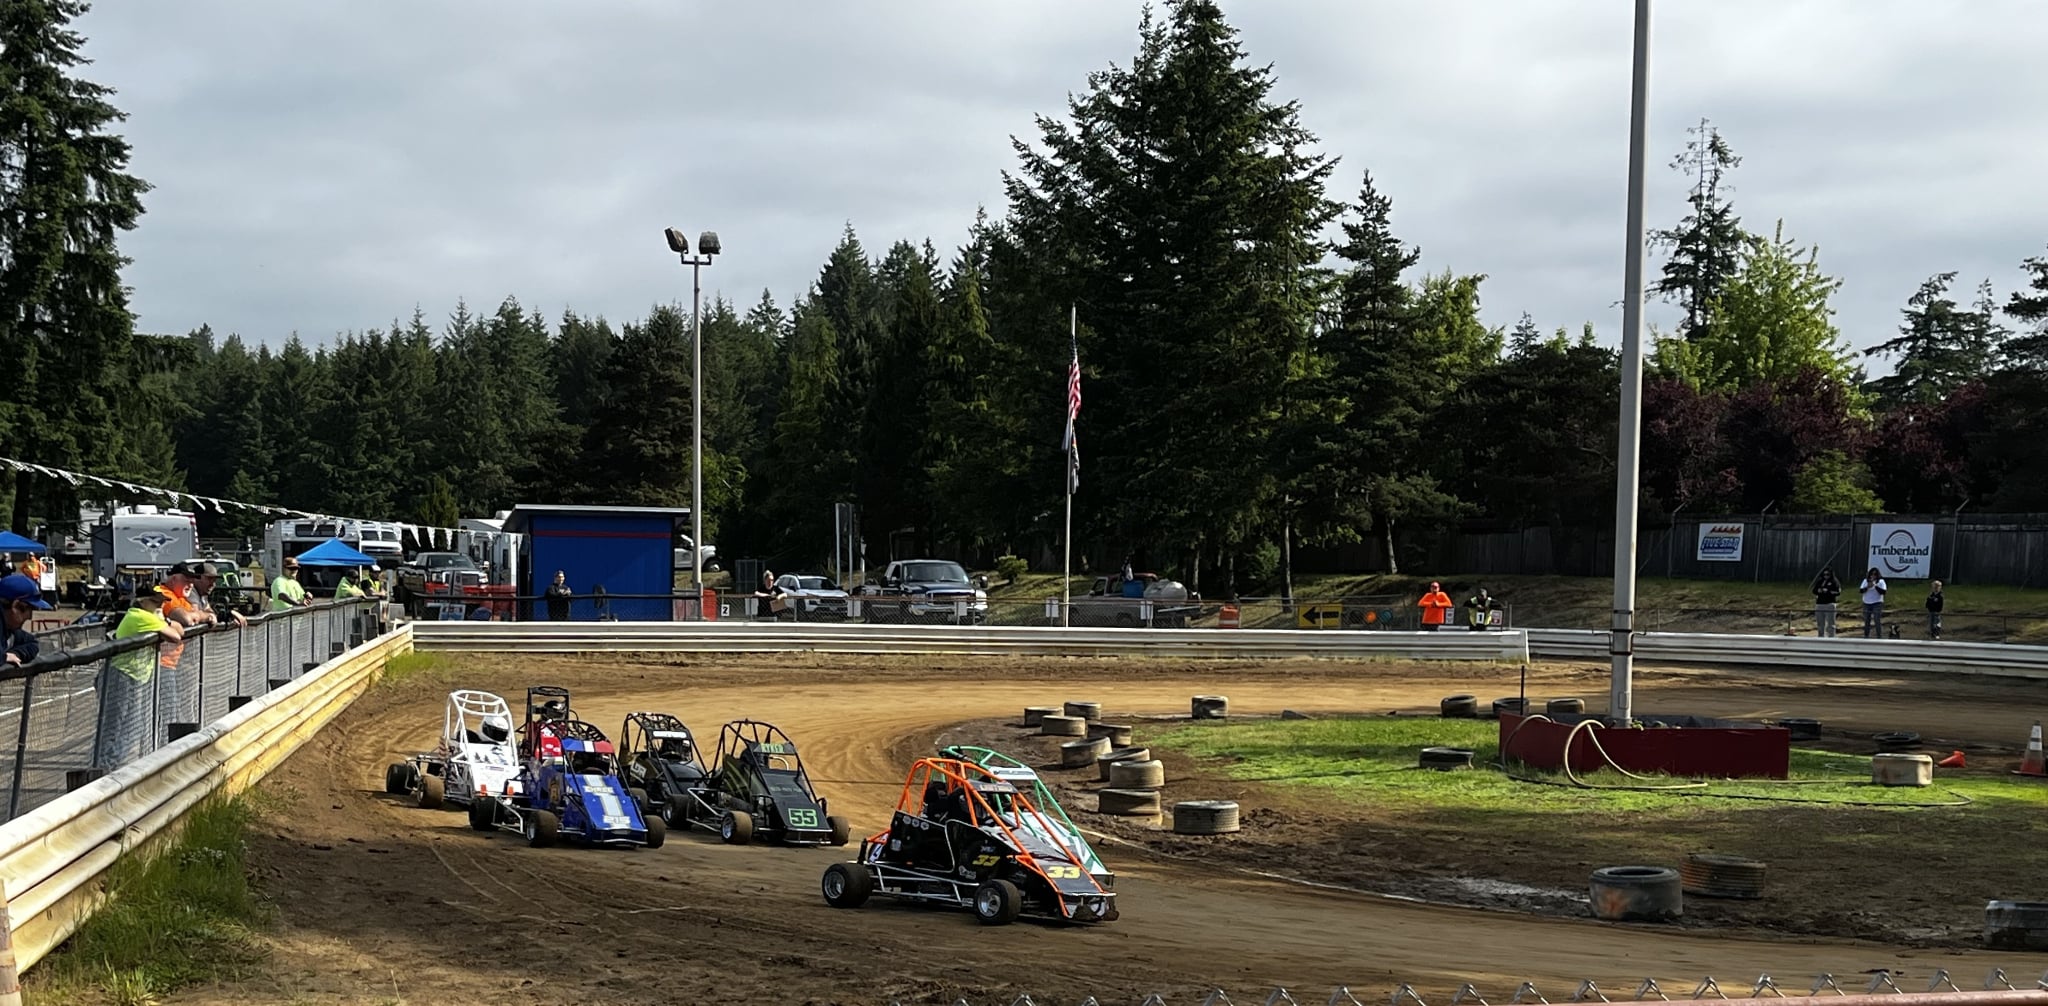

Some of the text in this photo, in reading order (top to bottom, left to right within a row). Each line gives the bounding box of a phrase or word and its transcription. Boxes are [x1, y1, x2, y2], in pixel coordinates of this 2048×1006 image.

[1871, 545, 1929, 556] Timberland
[1899, 556, 1919, 564] Bank
[722, 606, 728, 615] 2
[788, 808, 818, 827] 55
[972, 854, 1001, 867] 33
[1047, 866, 1081, 879] 33
